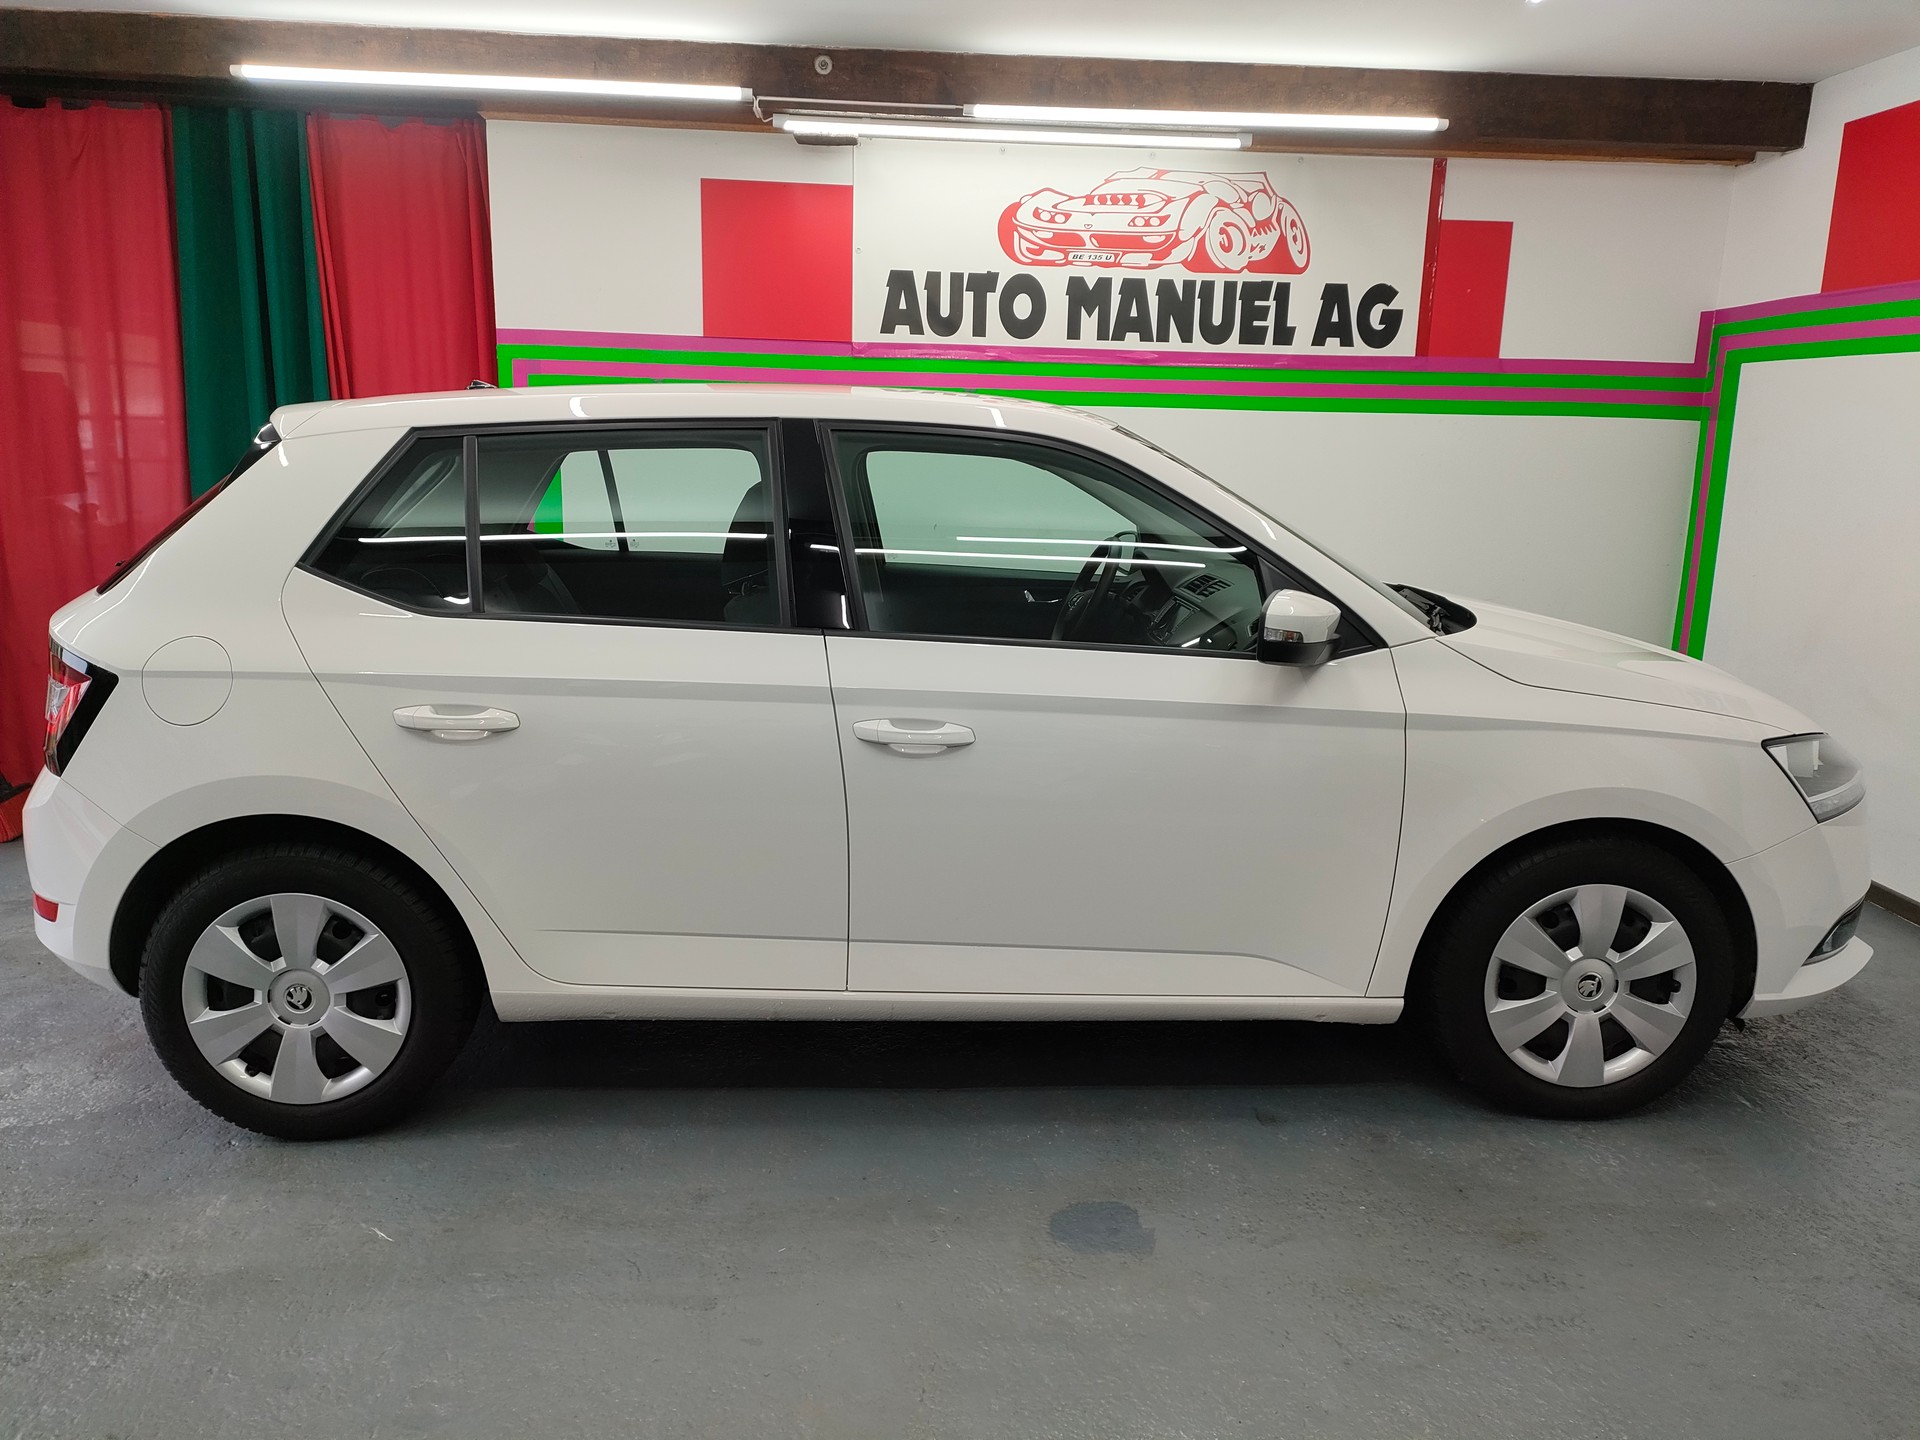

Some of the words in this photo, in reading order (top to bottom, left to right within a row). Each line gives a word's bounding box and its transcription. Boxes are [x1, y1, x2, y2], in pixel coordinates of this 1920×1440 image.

[879, 269, 1047, 340] AUTO
[1065, 276, 1297, 346] MANUEL
[1311, 282, 1404, 349] AG
